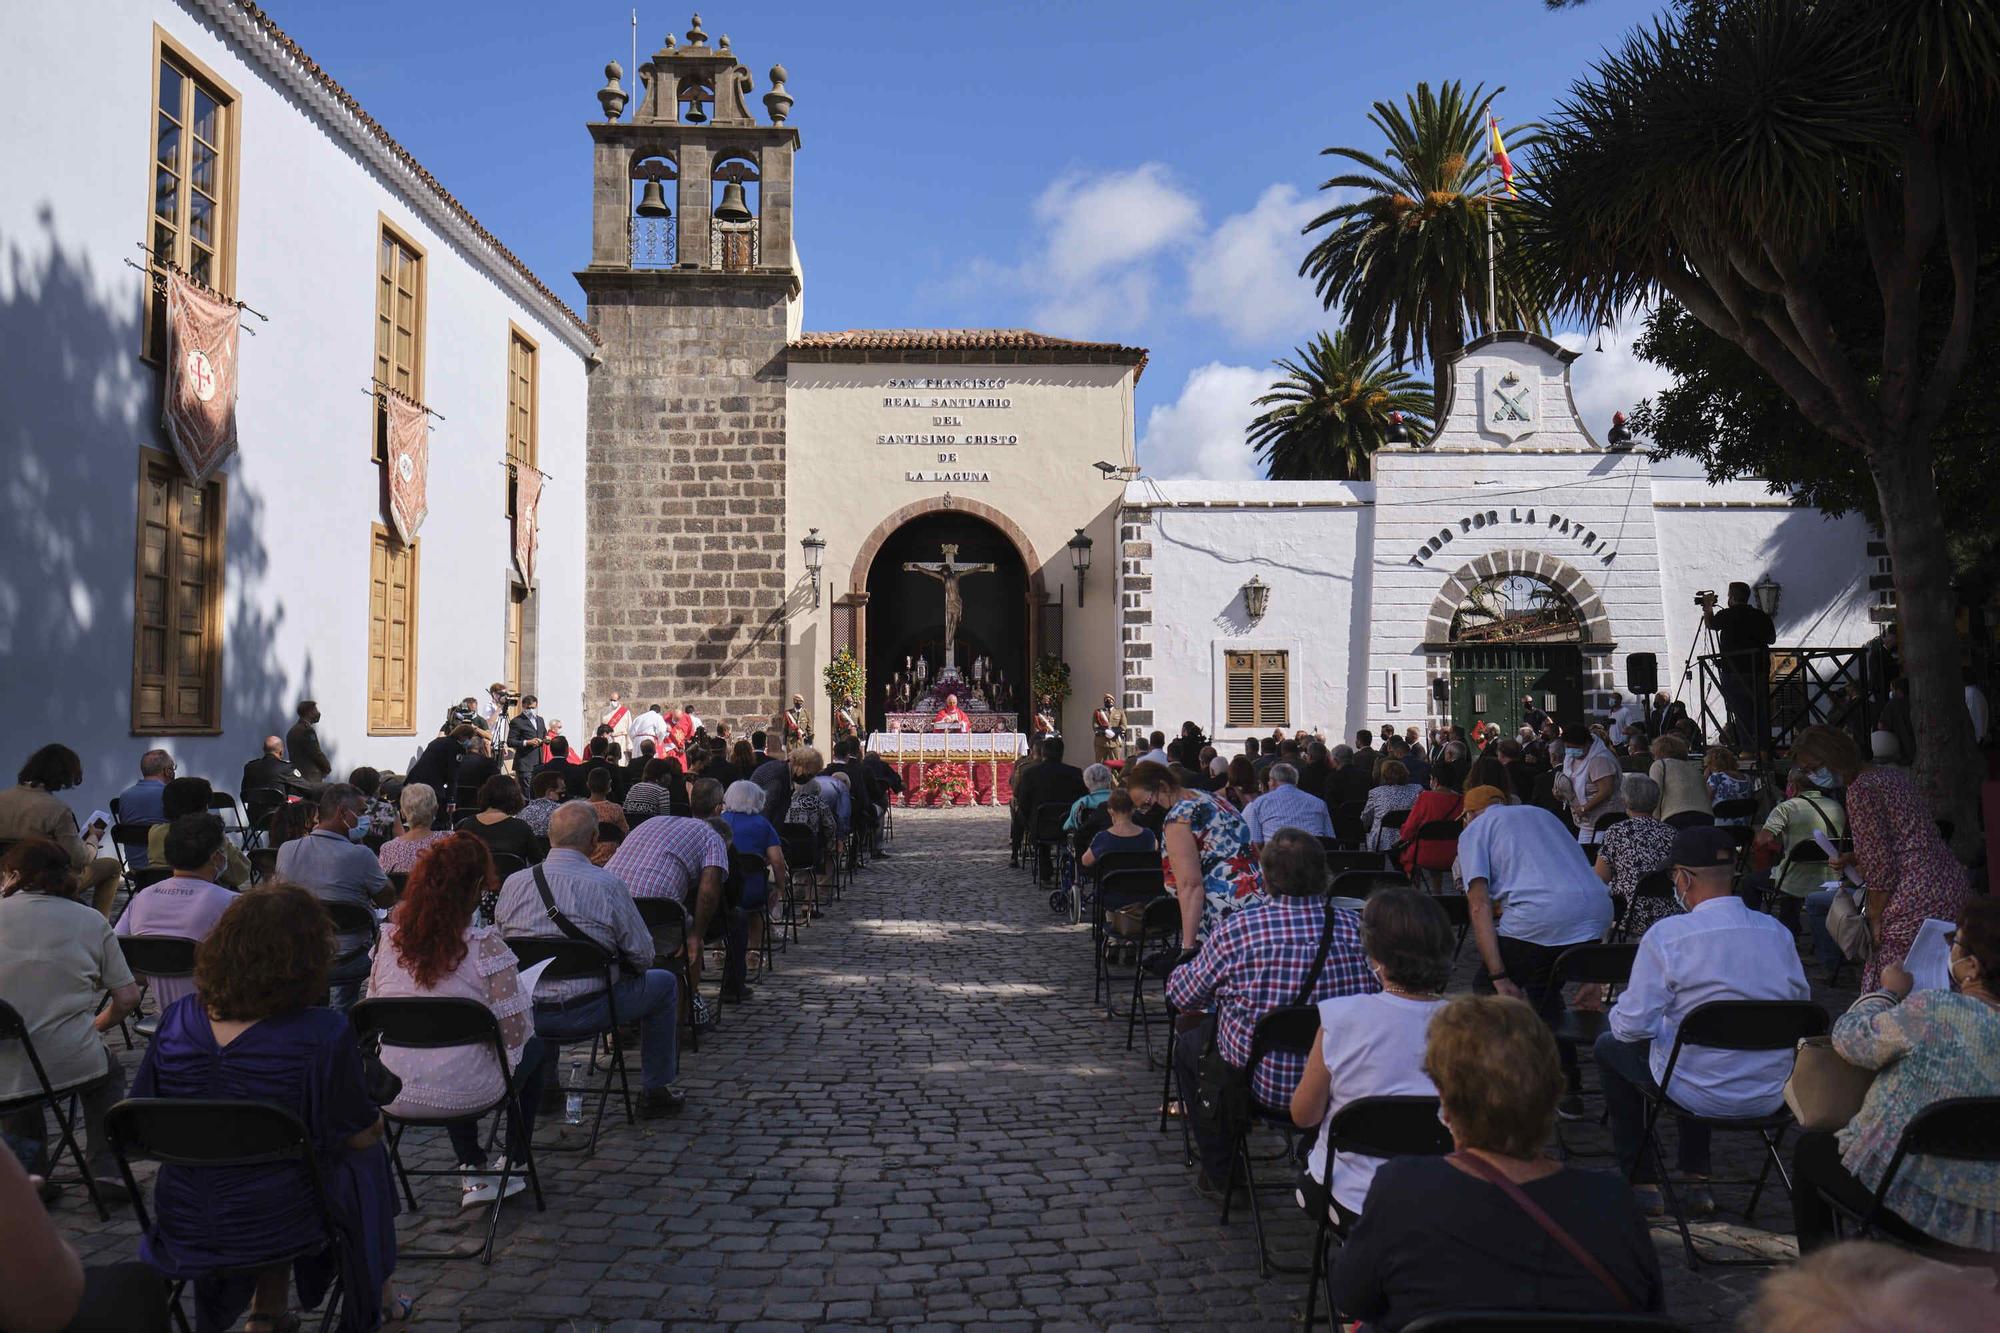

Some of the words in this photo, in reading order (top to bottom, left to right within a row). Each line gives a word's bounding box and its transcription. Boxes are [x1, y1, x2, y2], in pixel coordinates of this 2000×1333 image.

[889, 379, 916, 388] SAN
[926, 379, 1006, 388] FRANCISCO
[884, 398, 921, 408] REAL
[931, 398, 1011, 408] SANTUARIO
[933, 416, 961, 425] DEL
[878, 435, 956, 444] SANTISIMO
[966, 435, 1018, 444] CRISTO
[939, 453, 957, 462] DE
[906, 472, 924, 481] LA
[934, 472, 990, 481] LAGUNA
[1408, 528, 1454, 568] TODO
[1459, 510, 1500, 534] POR
[1510, 508, 1536, 524] LA
[1549, 513, 1617, 567] PATRIA
